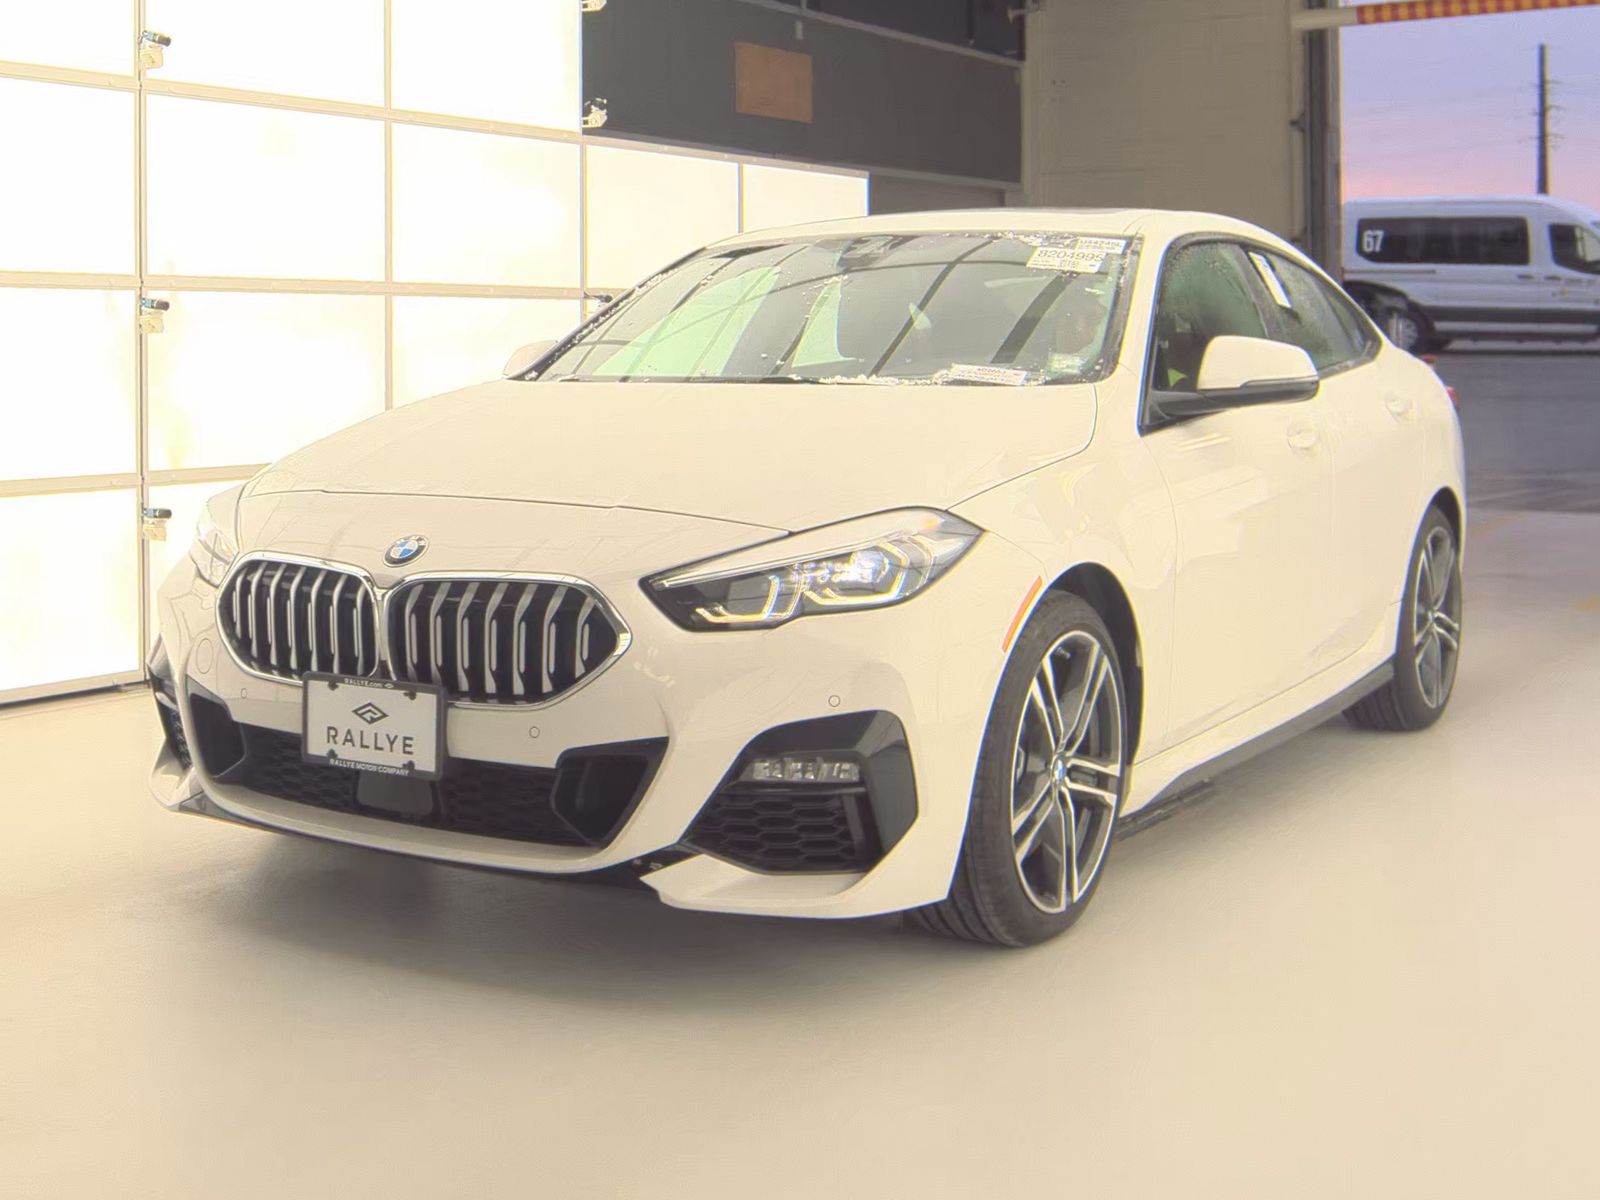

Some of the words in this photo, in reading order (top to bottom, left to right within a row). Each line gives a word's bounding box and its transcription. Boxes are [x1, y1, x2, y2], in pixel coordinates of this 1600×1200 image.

[1363, 230, 1384, 252] 67
[344, 678, 383, 689] RALLYE.com
[326, 726, 415, 756] RALLYE
[329, 758, 355, 769] RALLYE
[378, 766, 409, 776] COMPANY
